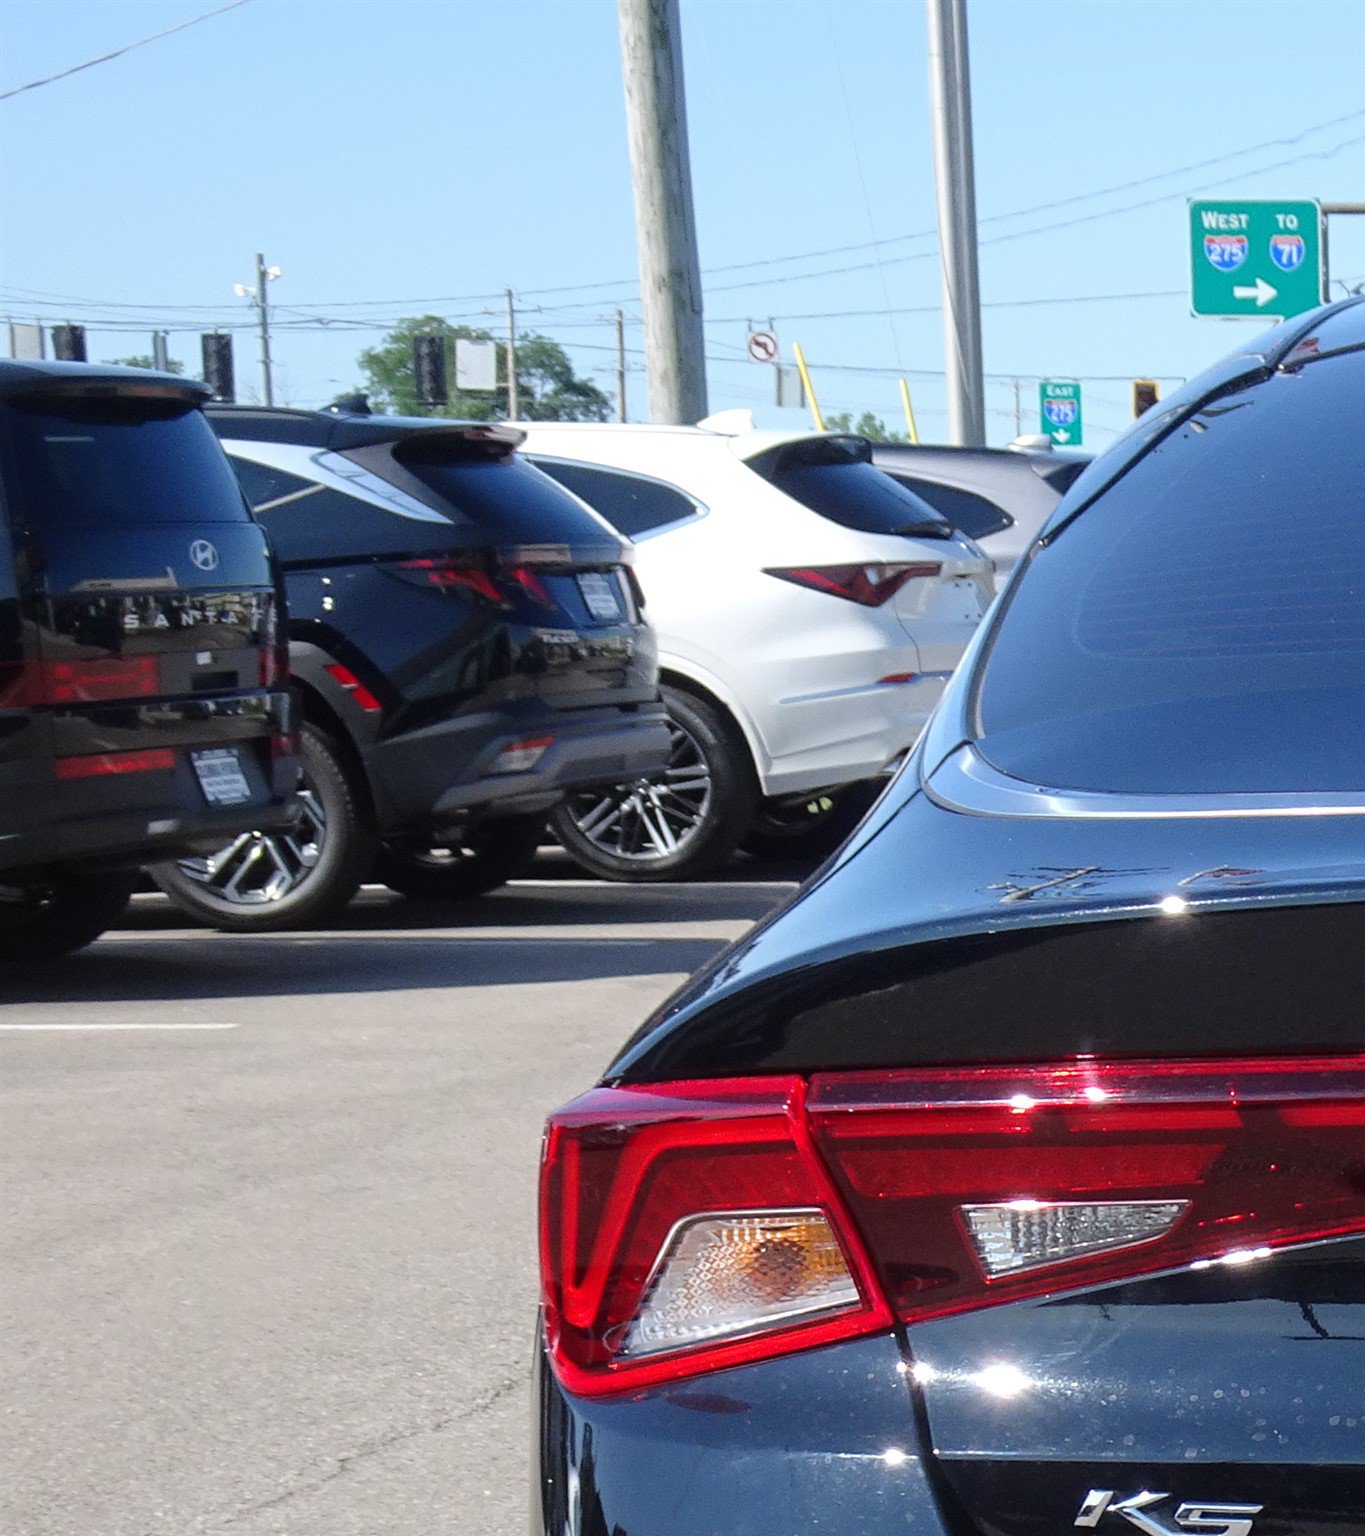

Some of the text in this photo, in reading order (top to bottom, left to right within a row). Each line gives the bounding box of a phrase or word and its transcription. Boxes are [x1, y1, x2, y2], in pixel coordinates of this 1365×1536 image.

[1201, 209, 1299, 230] WEST TO
[1208, 243, 1299, 264] 275 71
